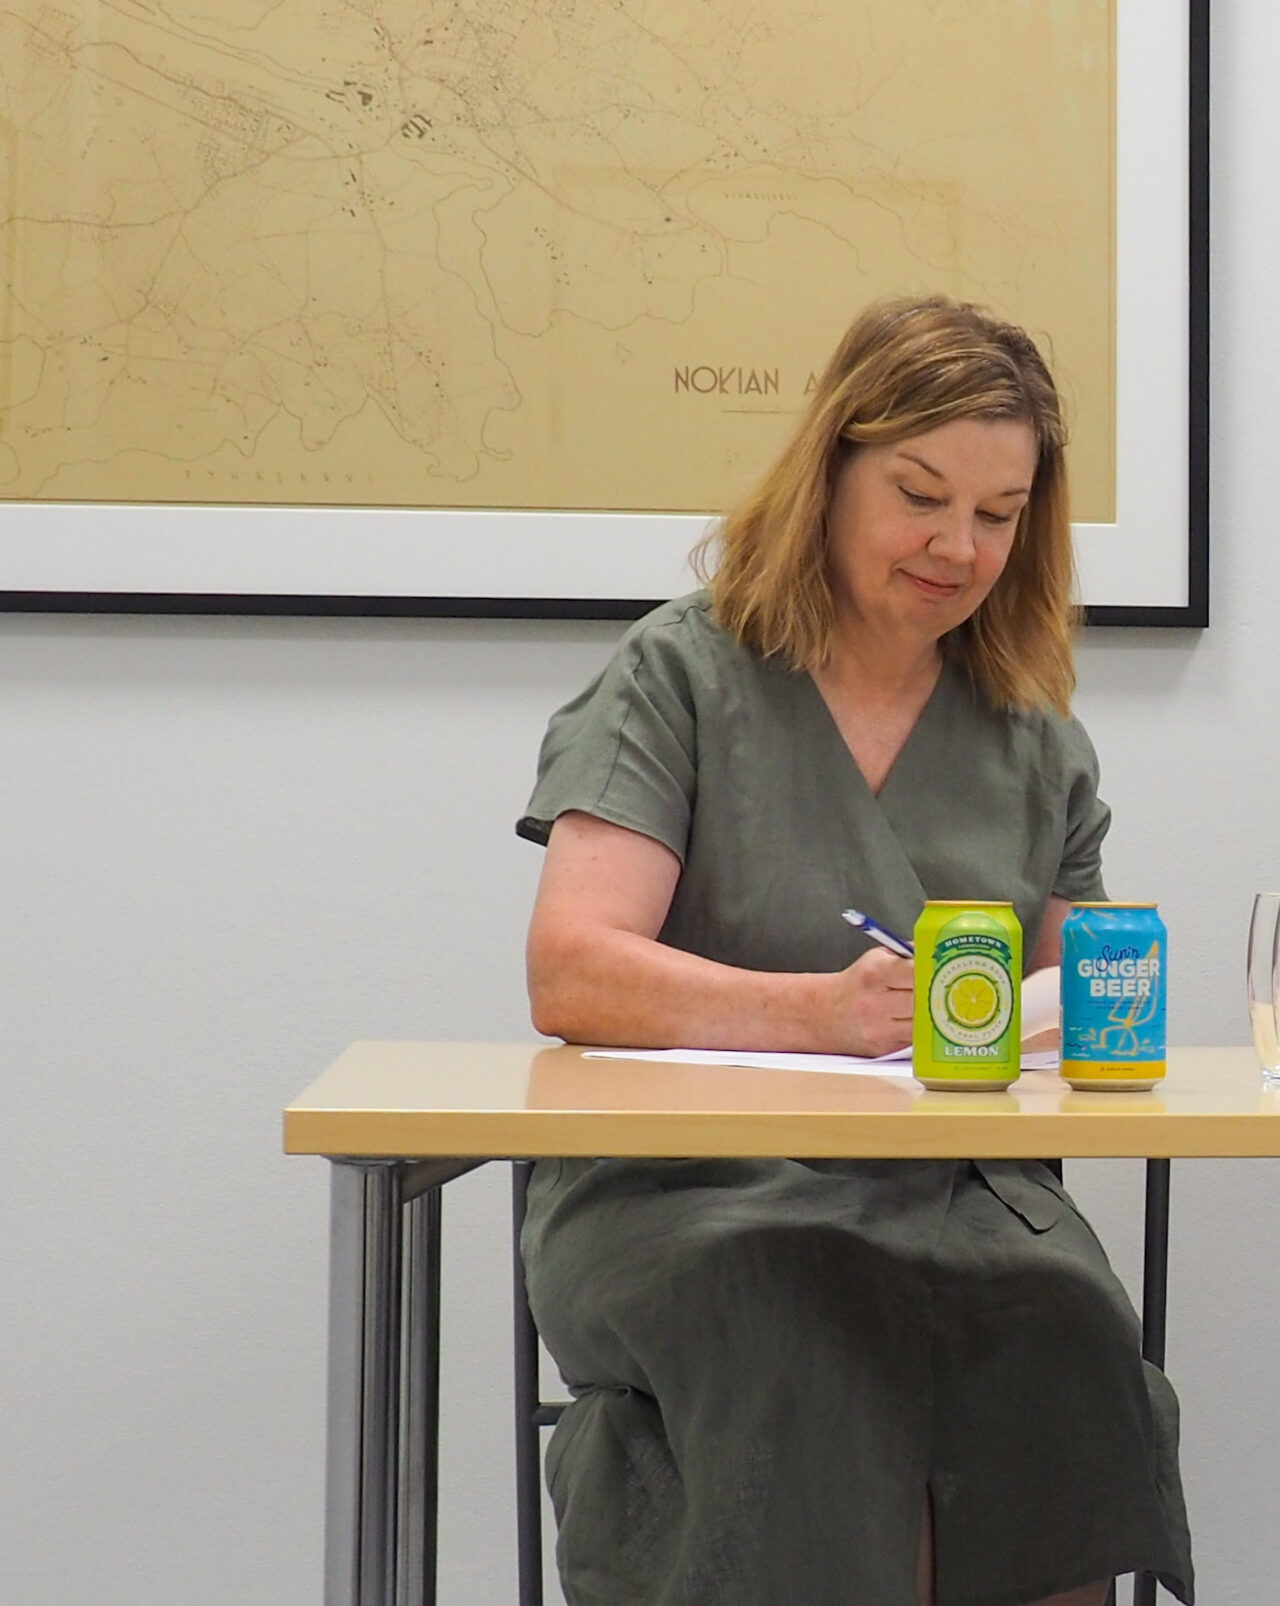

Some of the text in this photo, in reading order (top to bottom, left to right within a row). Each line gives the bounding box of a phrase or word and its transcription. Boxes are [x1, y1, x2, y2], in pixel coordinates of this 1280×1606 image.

[674, 366, 779, 394] NOKIAN
[945, 936, 1002, 948] HOMETOWN
[1077, 958, 1160, 978] GINGER
[1090, 979, 1151, 997] BEER
[945, 1046, 999, 1057] LEMON
